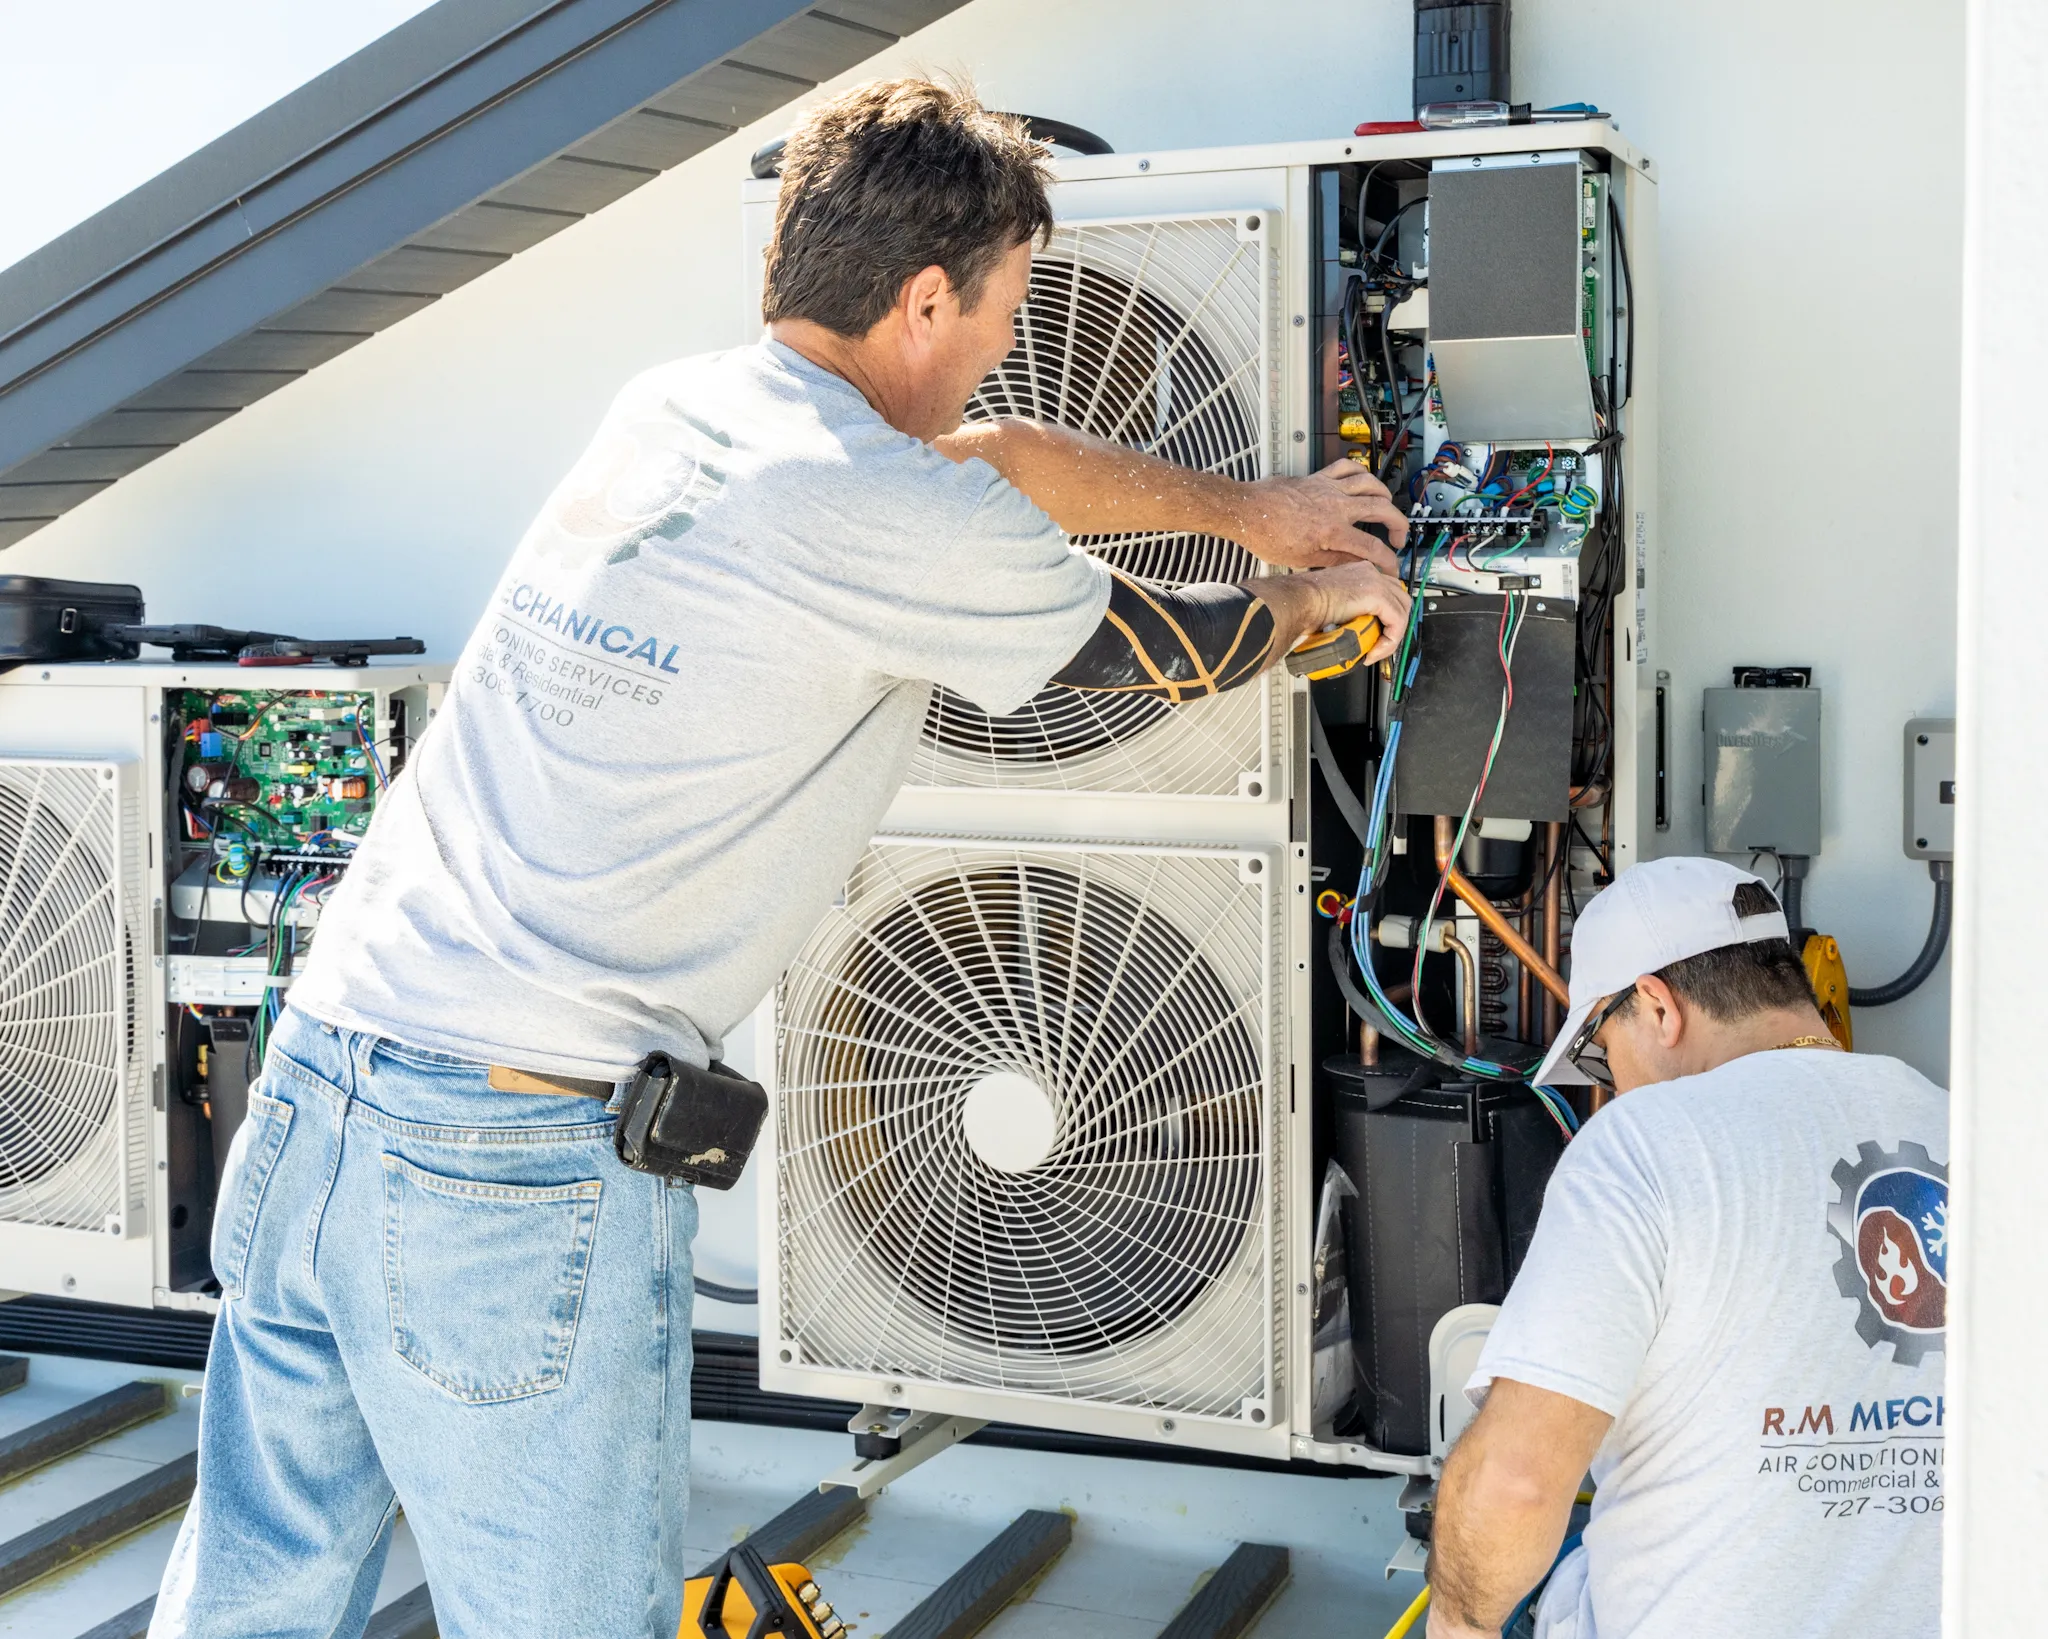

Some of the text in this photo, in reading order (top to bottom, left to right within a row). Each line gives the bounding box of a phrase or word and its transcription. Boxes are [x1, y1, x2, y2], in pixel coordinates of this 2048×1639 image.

[502, 579, 681, 674] CHANICAL
[499, 653, 512, 671] &
[512, 661, 604, 710] Residential
[548, 655, 664, 706] SERVICES
[1758, 1456, 1797, 1474] AIR
[1798, 1470, 1940, 1493] Commercial &
[1821, 1495, 1944, 1518] 727-306
